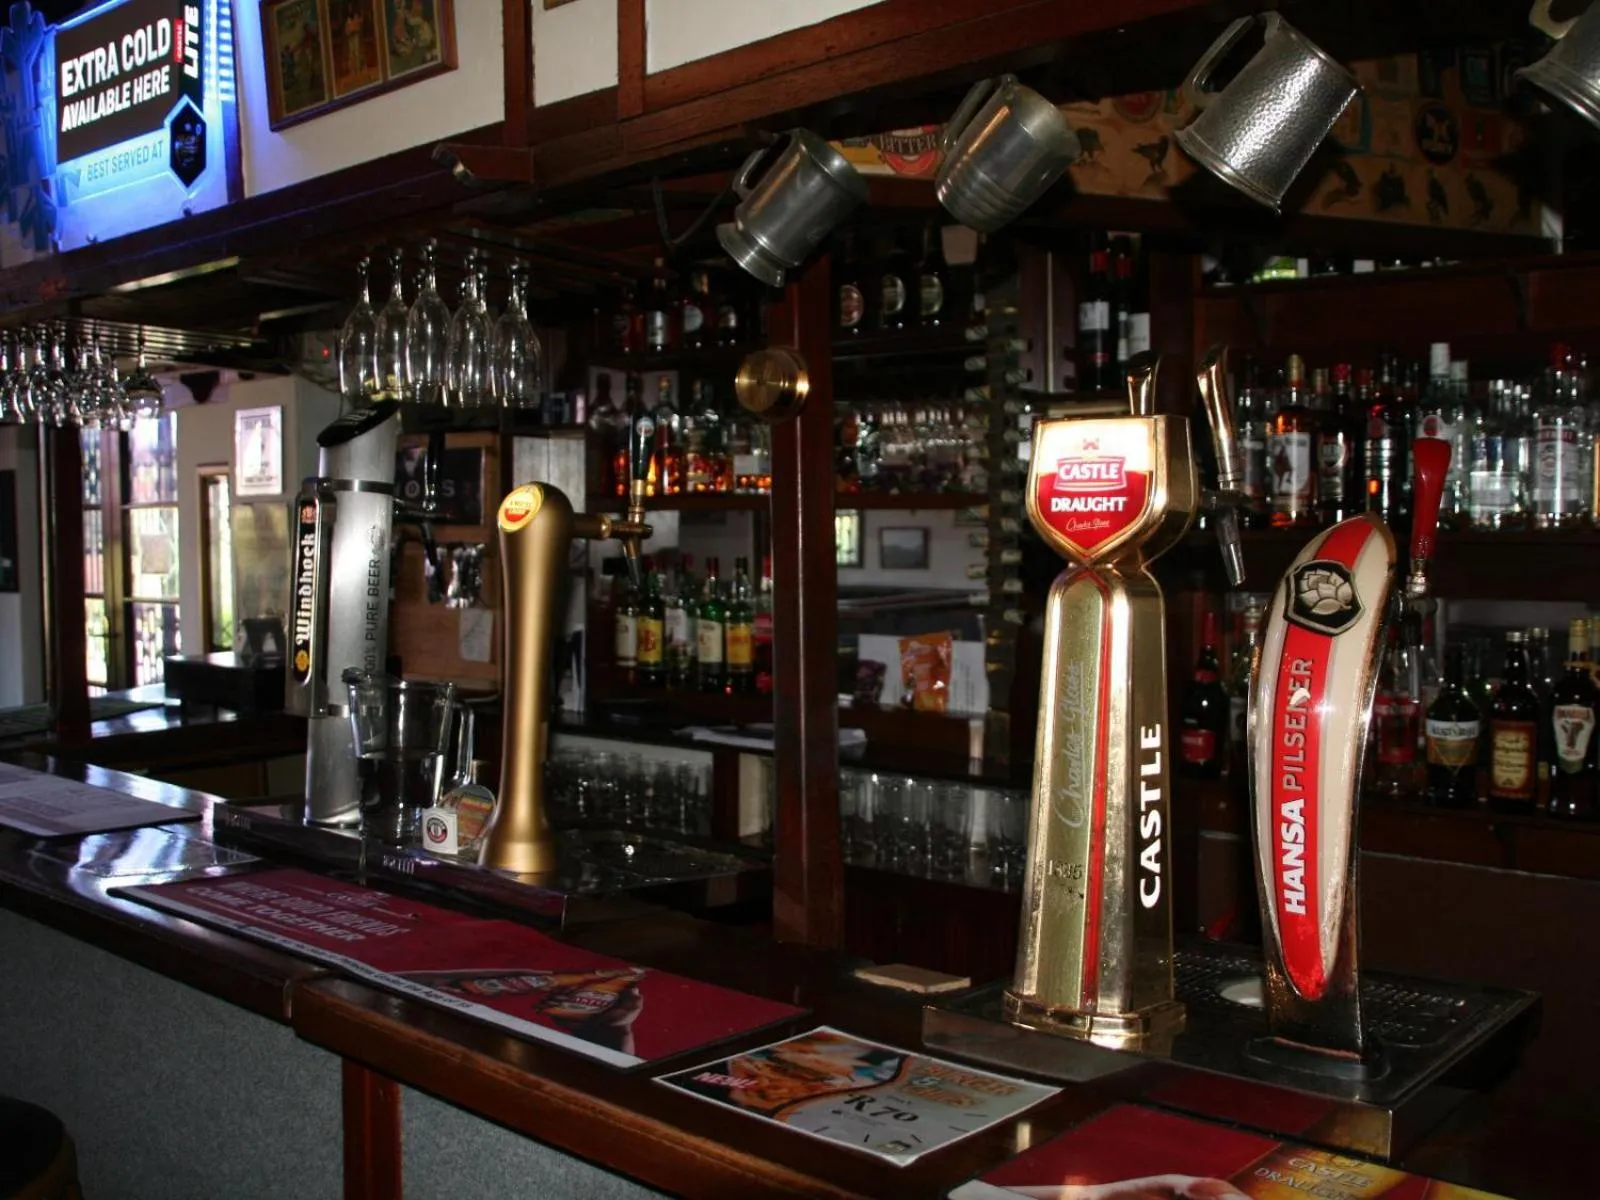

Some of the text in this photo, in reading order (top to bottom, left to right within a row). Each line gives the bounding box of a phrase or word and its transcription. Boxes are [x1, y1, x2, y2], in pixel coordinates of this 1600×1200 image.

[61, 17, 171, 97] EXTRA COLD
[184, 5, 199, 79] LITE
[61, 65, 171, 132] AVAILABLE HERE
[87, 159, 109, 181] BEST
[111, 146, 149, 174] SERVED
[152, 140, 164, 162] AT
[1060, 463, 1120, 480] CASTLE
[1051, 496, 1128, 512] DRAUGHT
[367, 559, 381, 597] BEER
[364, 601, 380, 640] PURE
[1281, 657, 1314, 916] HANSA PILSENER
[1140, 723, 1162, 909] CASTLE
[247, 904, 367, 941] TOGETHER
